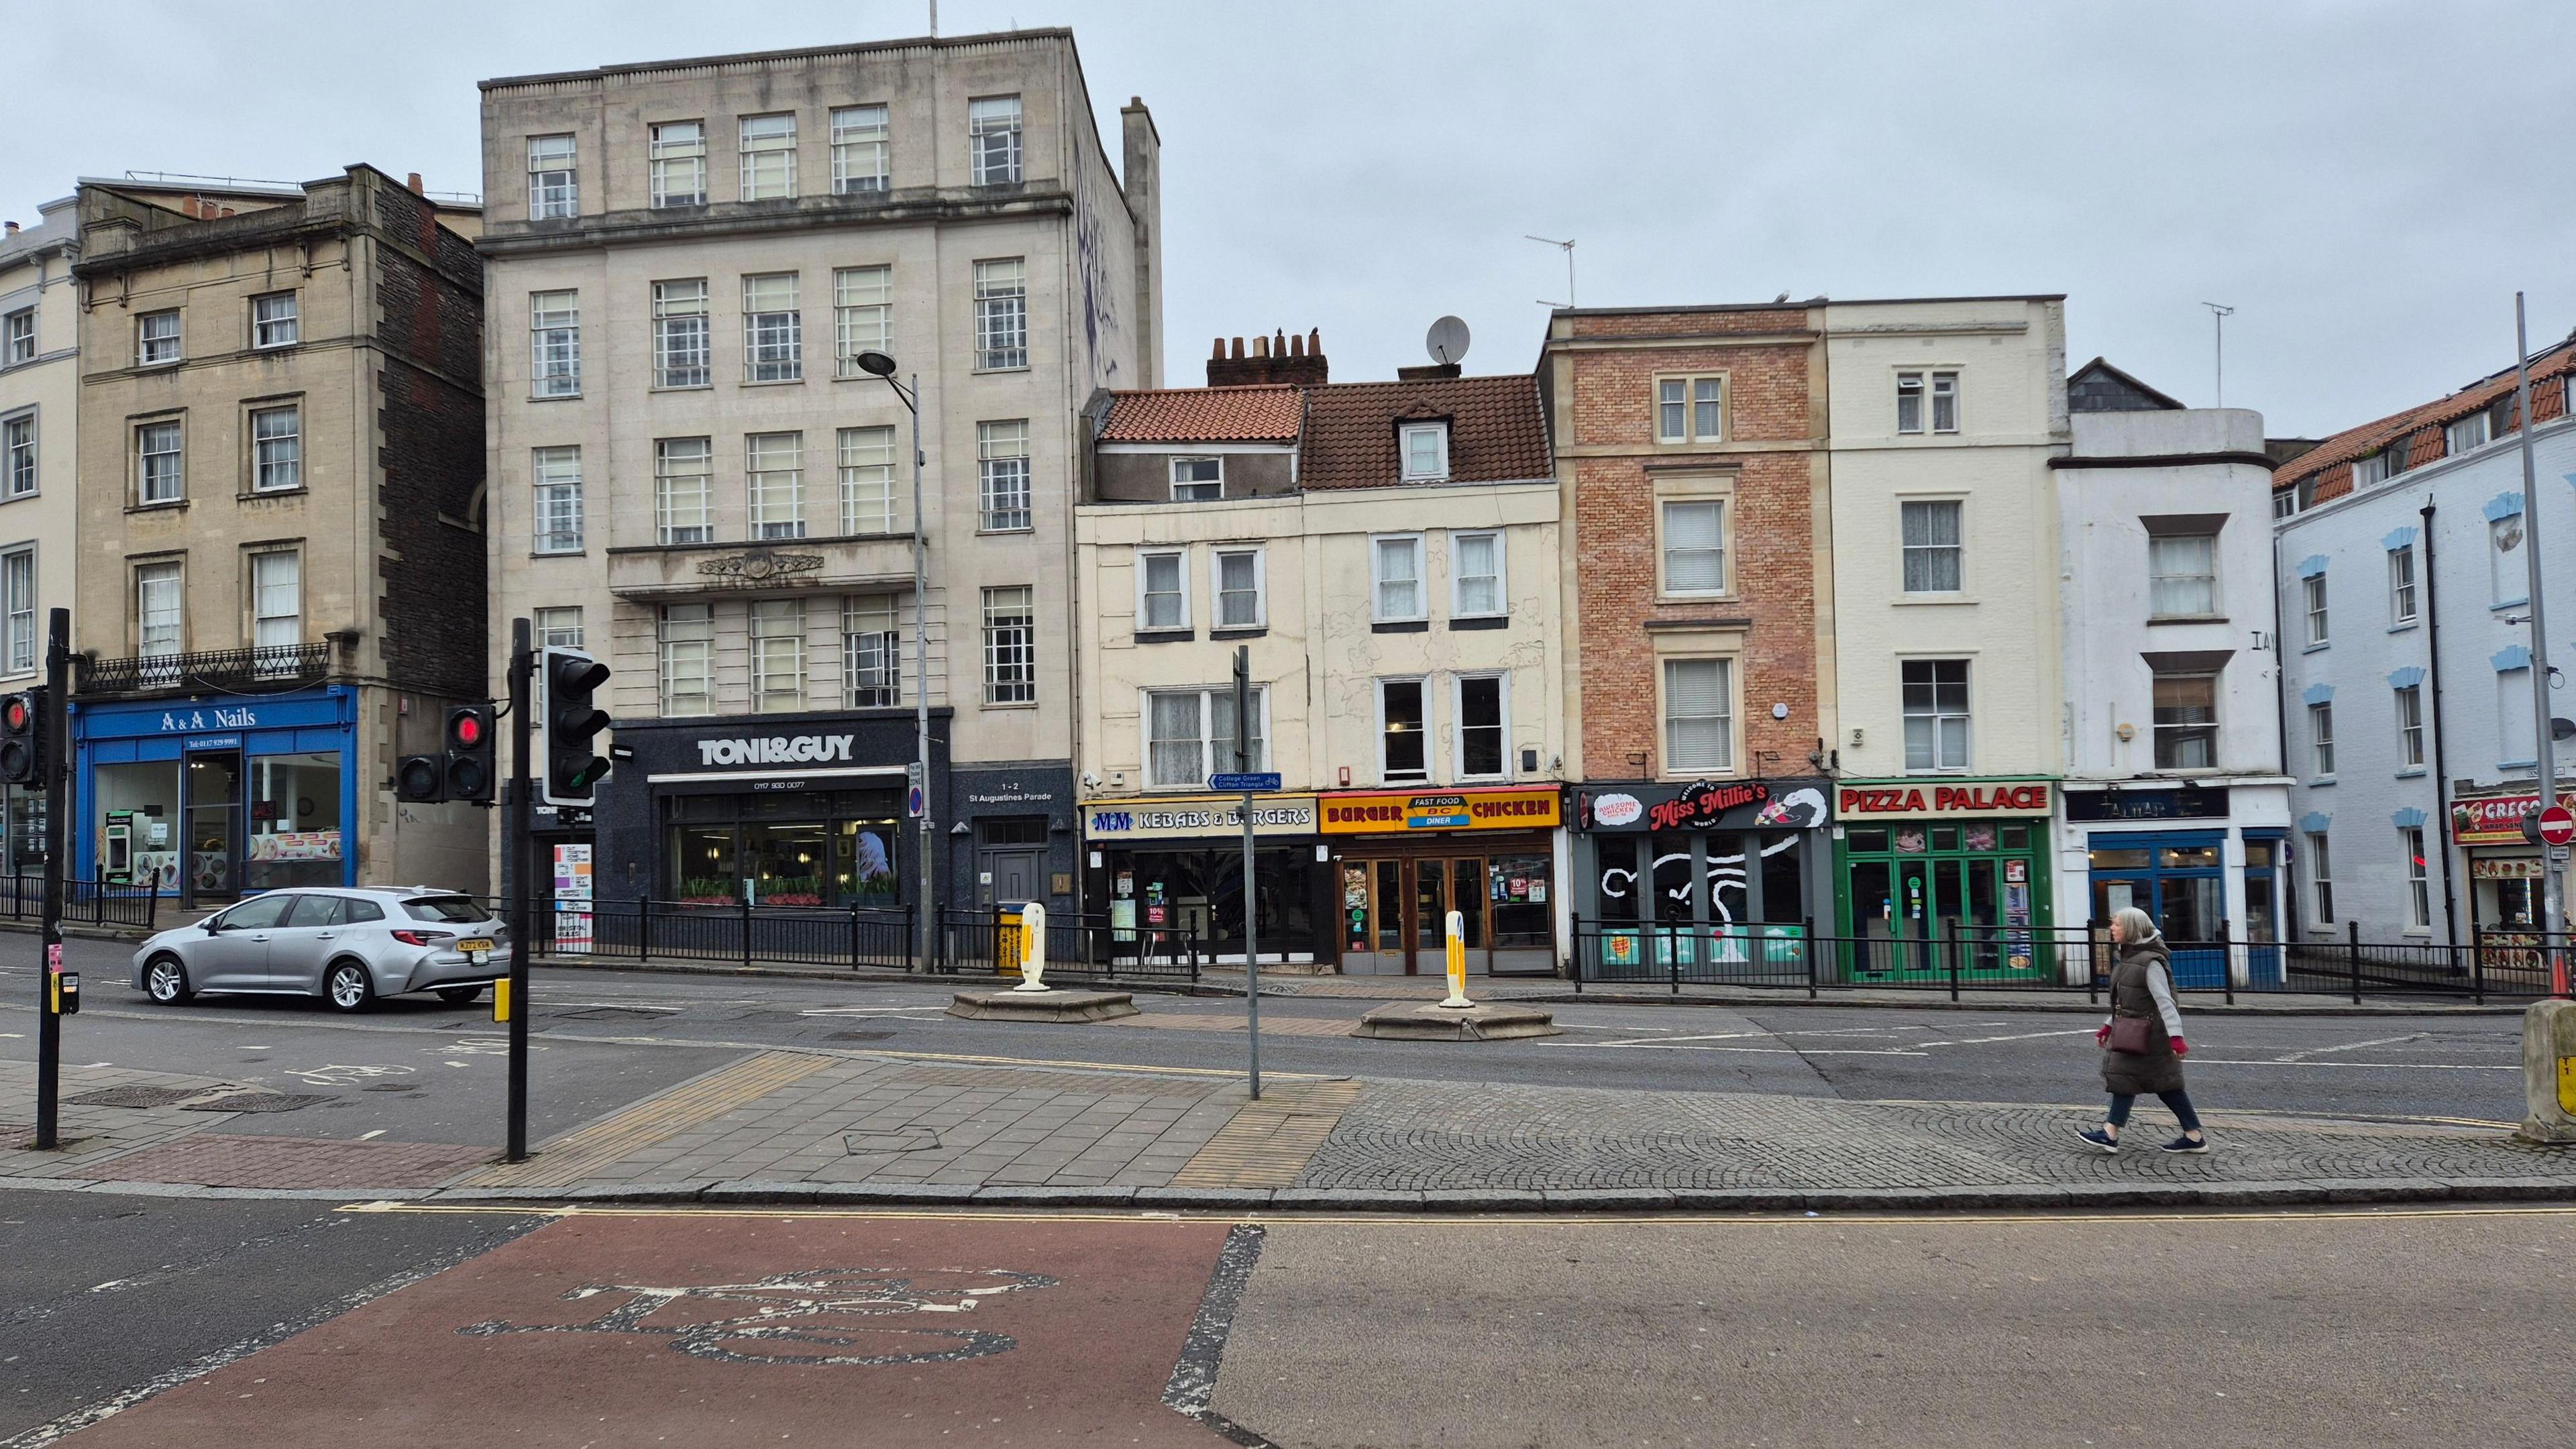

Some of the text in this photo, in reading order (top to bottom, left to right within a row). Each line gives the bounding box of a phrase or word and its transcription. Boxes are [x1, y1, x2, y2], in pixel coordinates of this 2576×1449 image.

[162, 708, 256, 731] A & A Nails
[199, 739, 213, 747] 0117
[213, 739, 223, 747] 929
[223, 738, 237, 746] 9991
[1681, 782, 1705, 801] WELCOME
[979, 794, 1022, 803] Augustines
[1415, 796, 1460, 806] FAST FOOD
[1840, 786, 2047, 812] PIZZA PALACE
[535, 806, 558, 814] TONI
[1327, 806, 1403, 823] BURGER
[1472, 800, 1550, 818] CHICKEN
[1599, 801, 1638, 813] AWESOME
[1603, 807, 1635, 816] CHICKEN
[1650, 784, 1766, 831] Miss Millie's
[1138, 810, 1210, 829] KEBABS
[1213, 813, 1223, 826] &
[1227, 808, 1310, 826] BRGERS
[1426, 817, 1451, 825] DINER
[1694, 817, 1717, 827] WORLD
[1511, 879, 1526, 887] 10%
[2563, 1057, 2570, 1065] T
